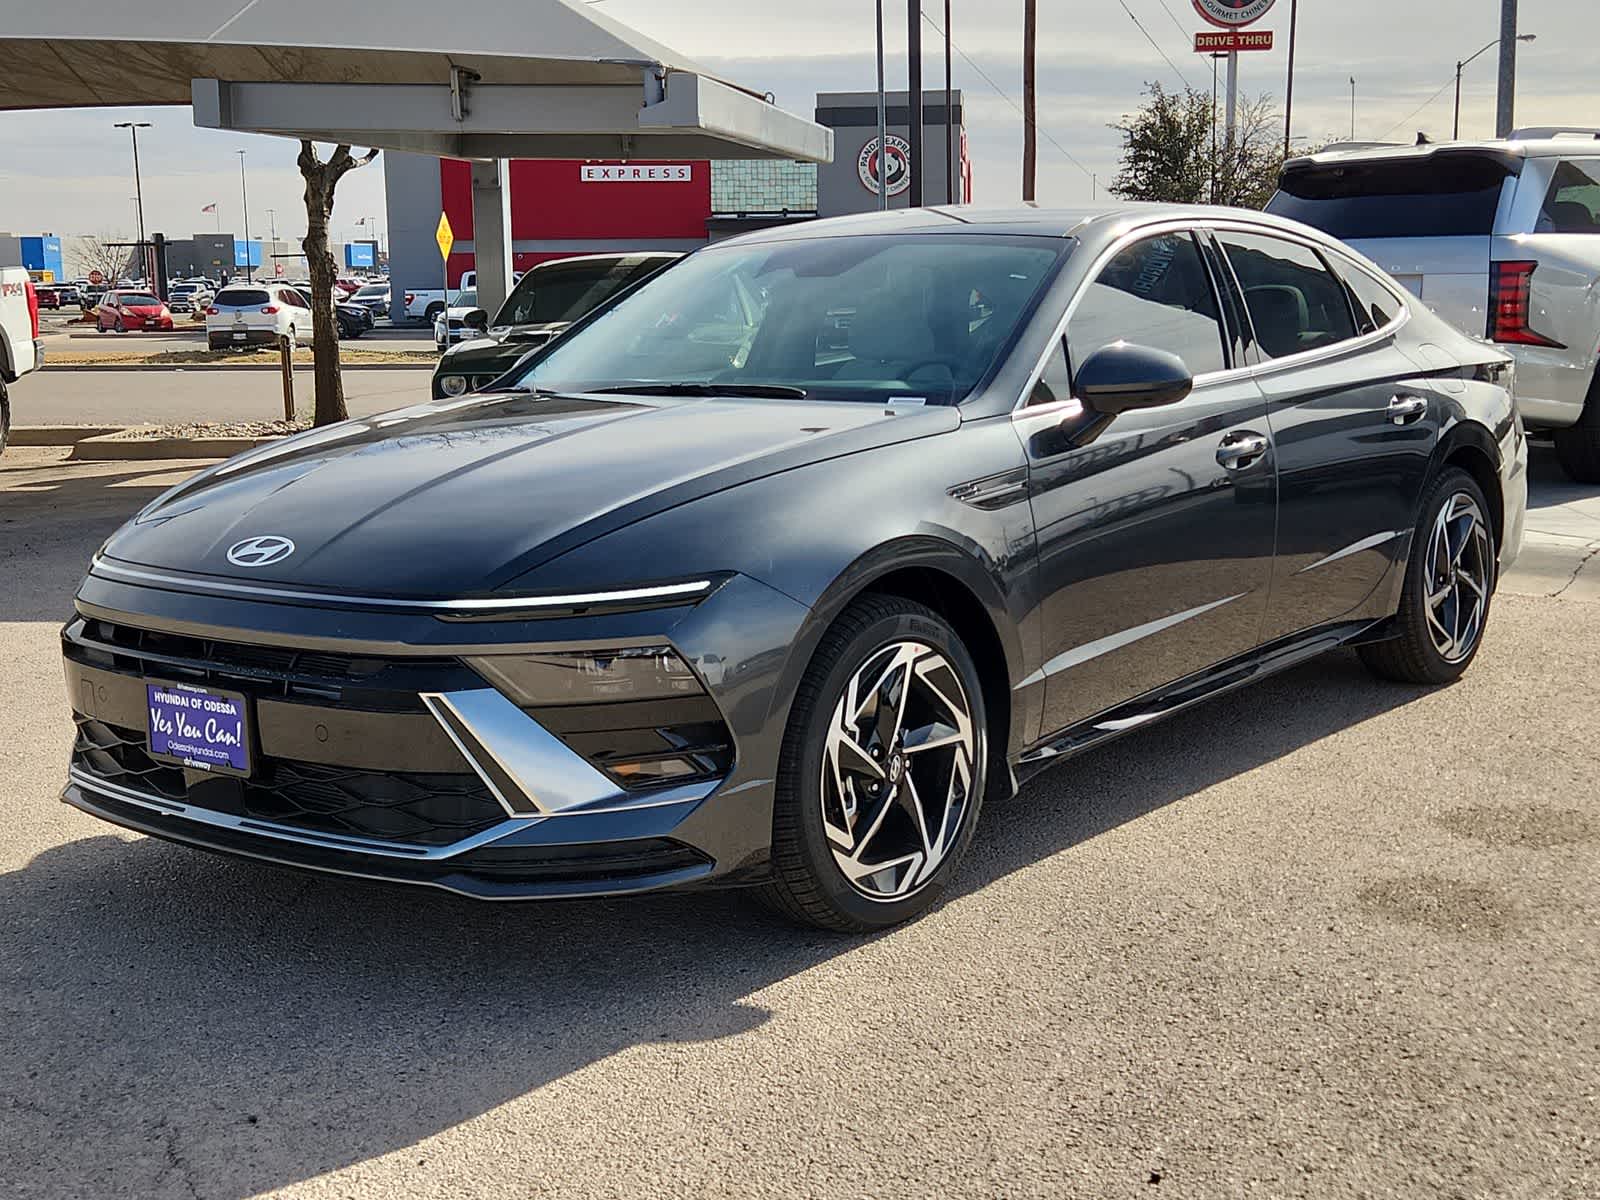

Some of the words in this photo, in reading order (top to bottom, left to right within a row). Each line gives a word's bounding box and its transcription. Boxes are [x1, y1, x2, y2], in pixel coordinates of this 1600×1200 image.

[1197, 36, 1234, 46] DRIVE
[1238, 35, 1272, 45] THRU
[587, 168, 686, 179] EXPRESS
[154, 691, 189, 707] HYUNDAI
[191, 698, 202, 709] OF
[203, 700, 237, 715] ODESSA
[151, 707, 173, 735] Yes
[175, 712, 202, 738] You
[205, 718, 242, 747] Can!
